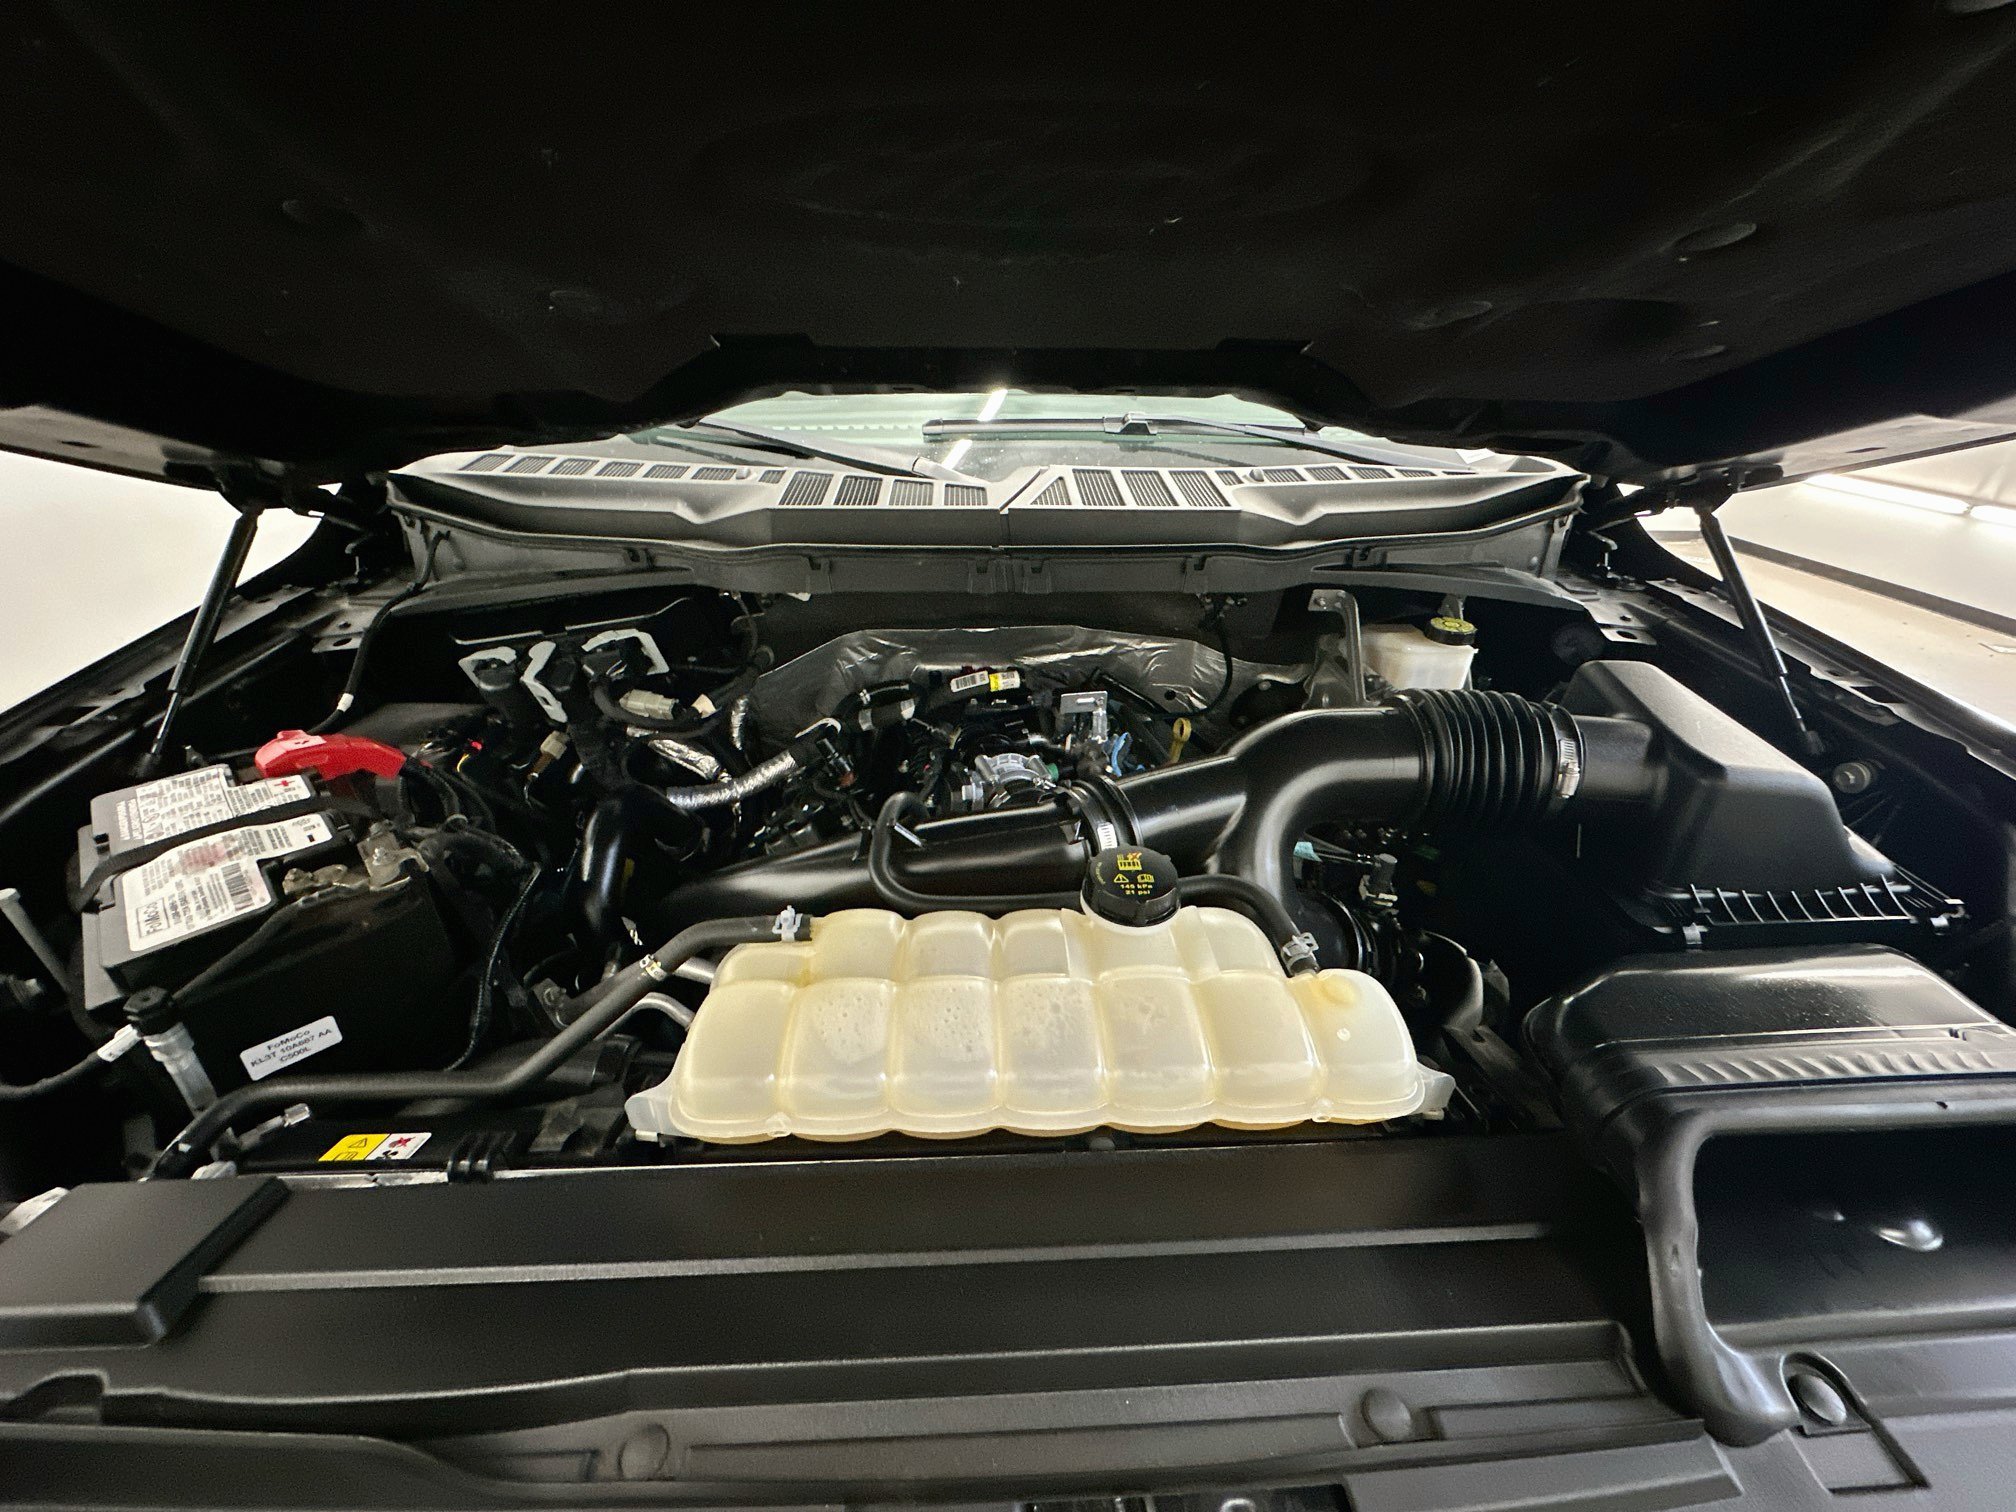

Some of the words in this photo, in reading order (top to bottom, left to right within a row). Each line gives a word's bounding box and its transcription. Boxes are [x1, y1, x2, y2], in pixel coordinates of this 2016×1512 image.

[250, 1051, 277, 1068] KL3T
[318, 1028, 332, 1038] AA
[266, 1030, 310, 1050] FoMoCo
[280, 1046, 312, 1062] C500L
